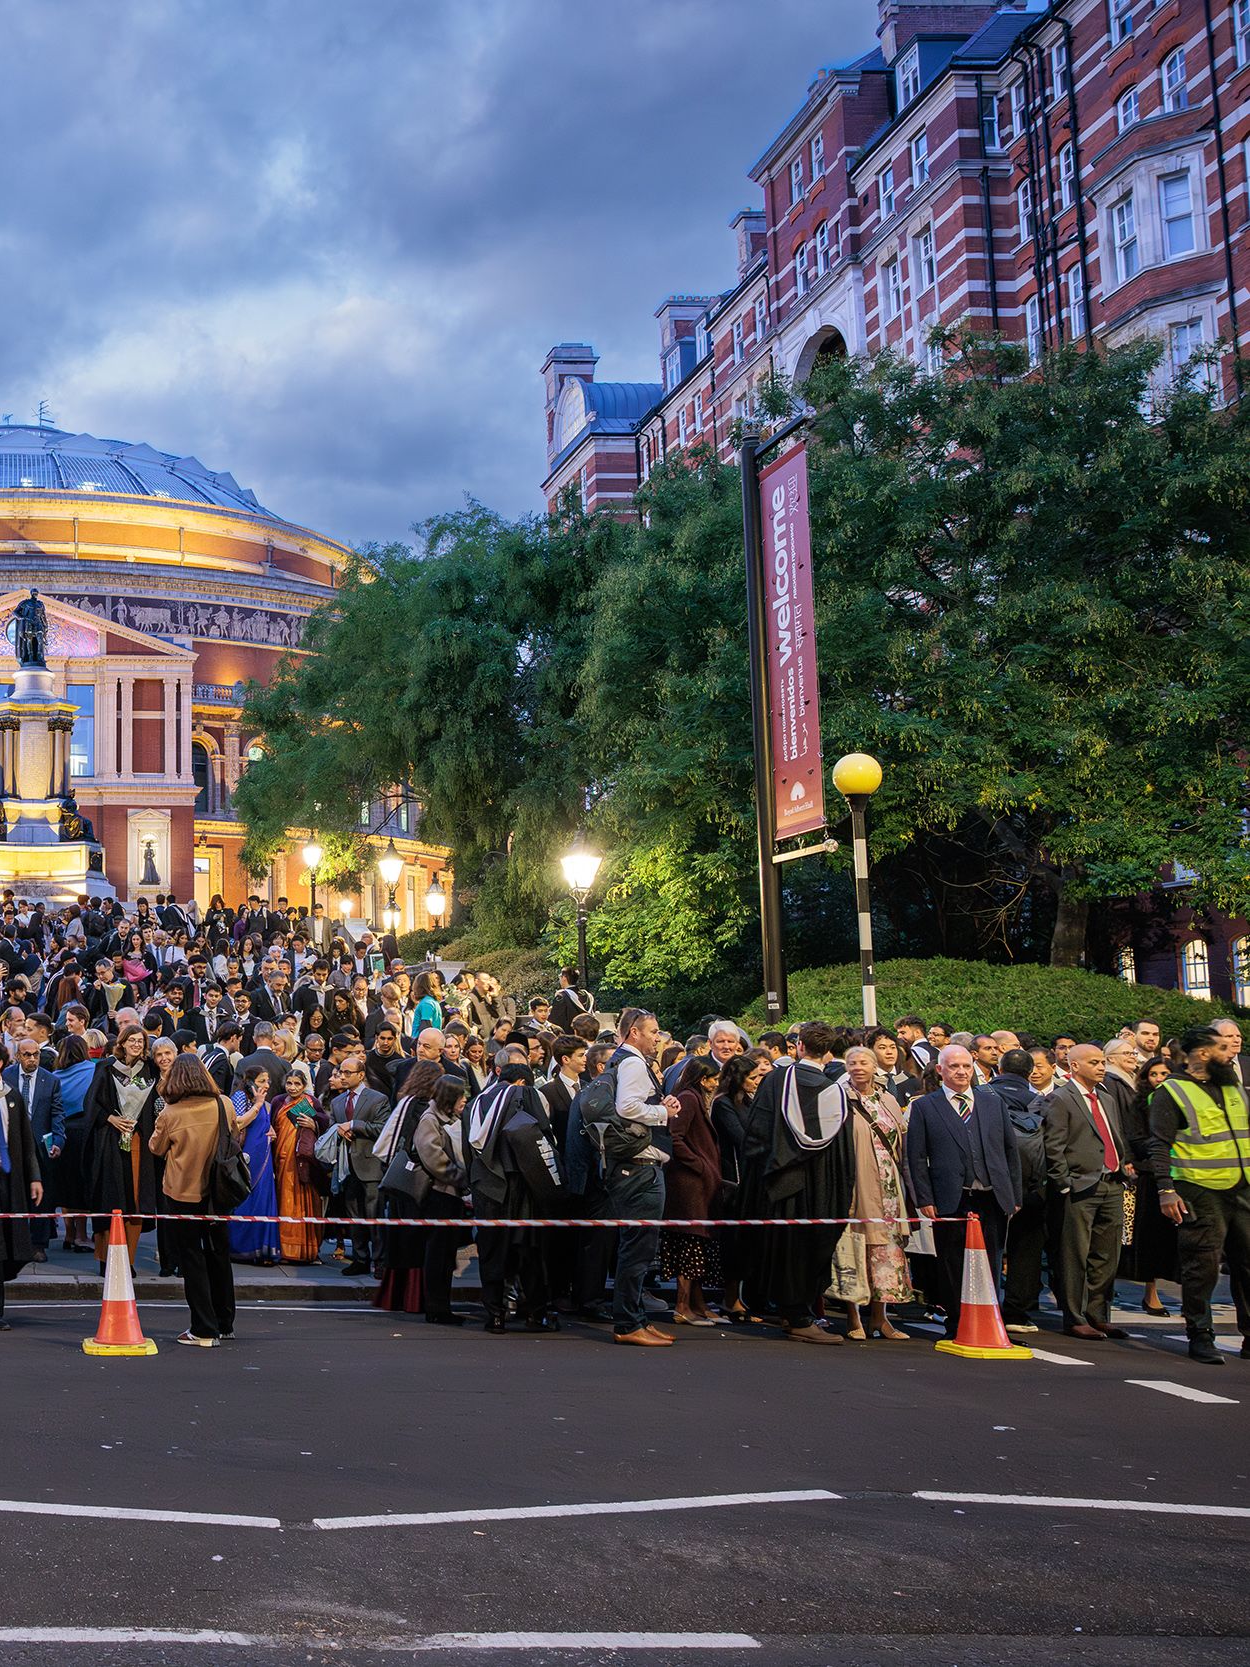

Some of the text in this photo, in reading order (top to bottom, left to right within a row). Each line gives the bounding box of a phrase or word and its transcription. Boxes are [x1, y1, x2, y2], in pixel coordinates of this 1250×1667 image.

[772, 484, 792, 668] welcome
[787, 667, 798, 760] bienvenidos
[797, 655, 806, 717] bienvenue
[867, 965, 873, 975] 1
